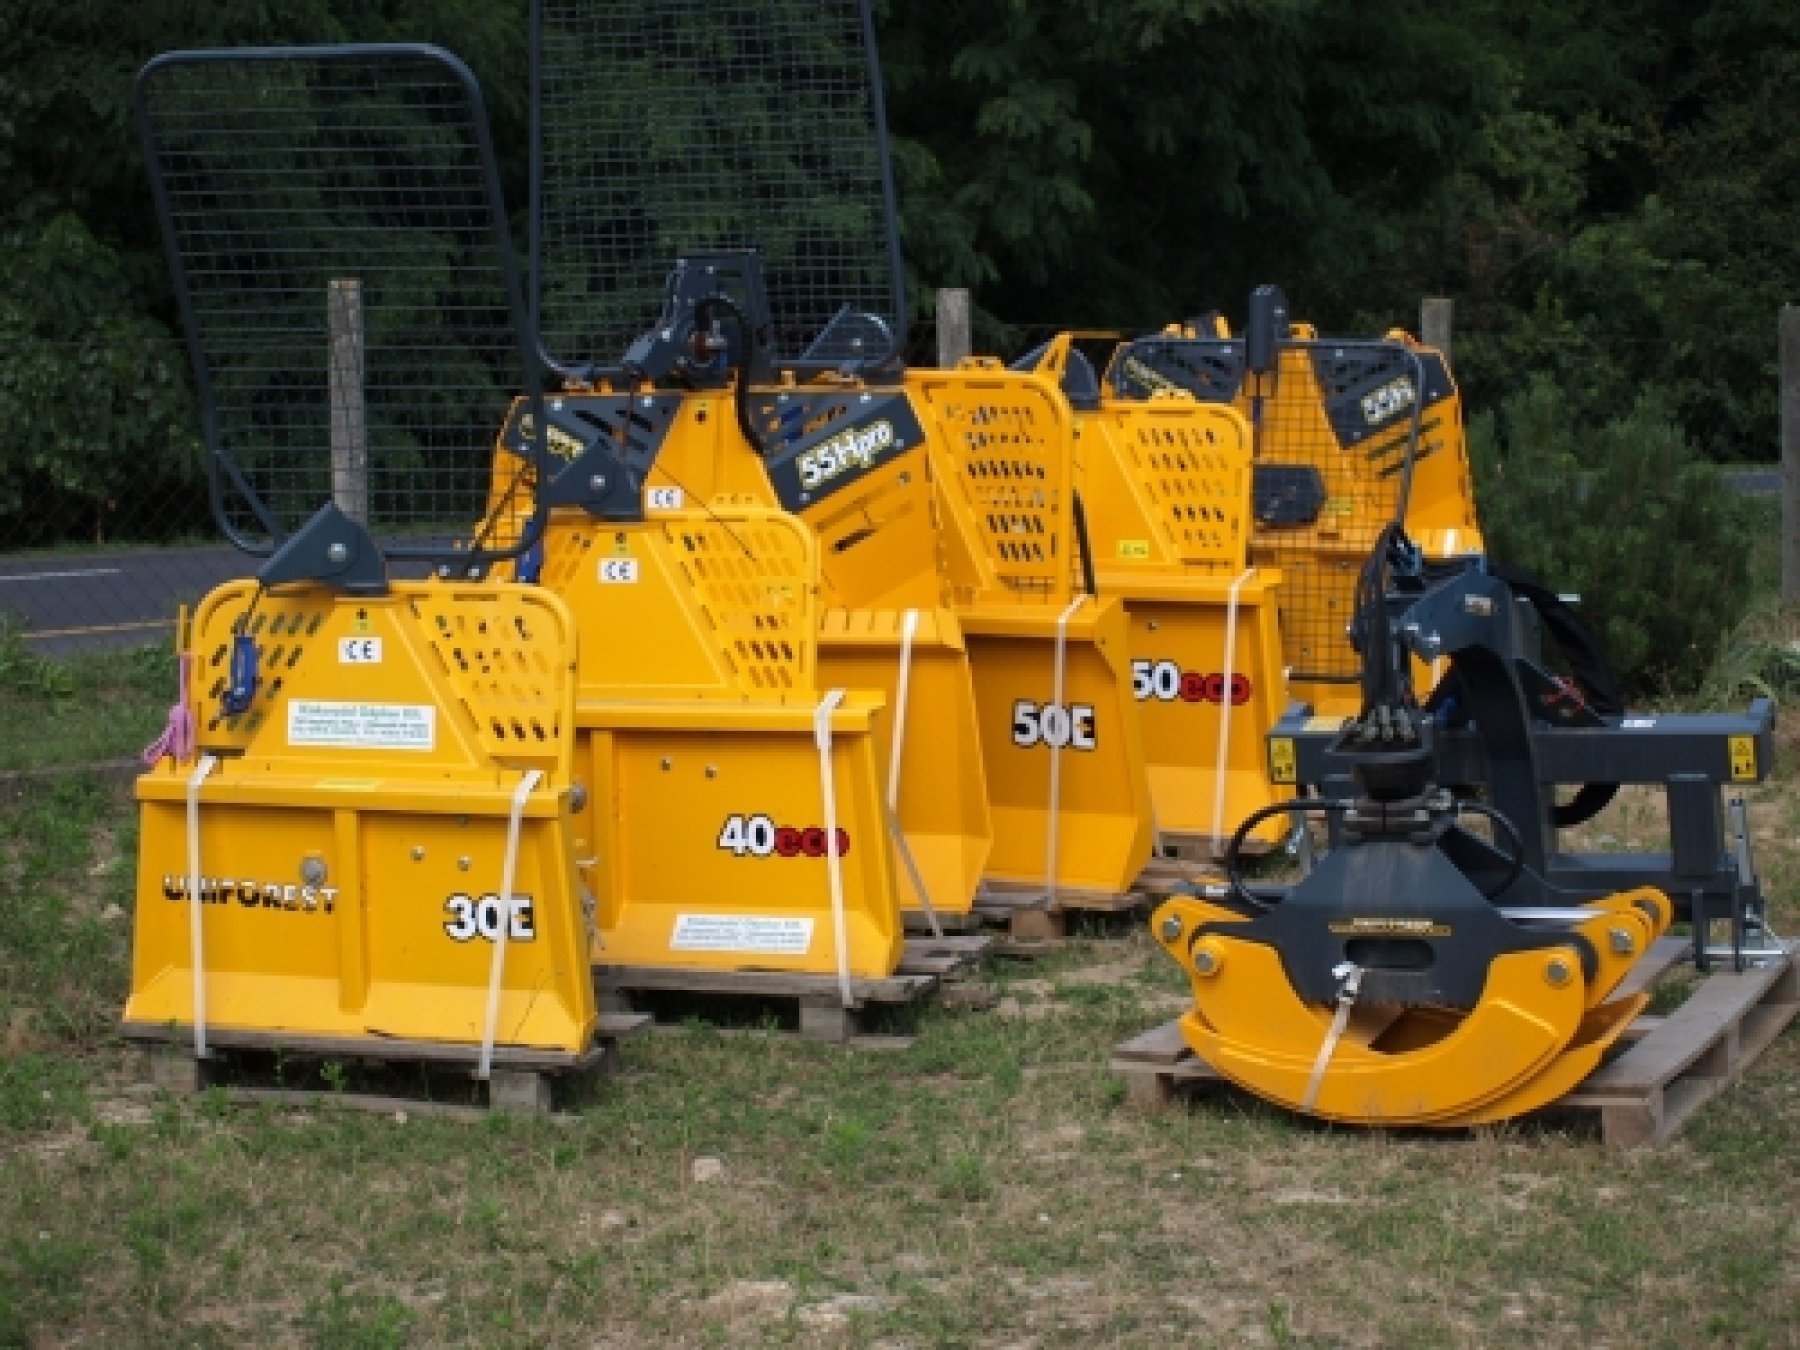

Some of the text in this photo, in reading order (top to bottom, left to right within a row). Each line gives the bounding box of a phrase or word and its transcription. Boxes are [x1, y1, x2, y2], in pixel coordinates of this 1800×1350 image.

[343, 639, 374, 661] CE
[1012, 699, 1096, 752] 50E
[443, 893, 536, 943] 30E
